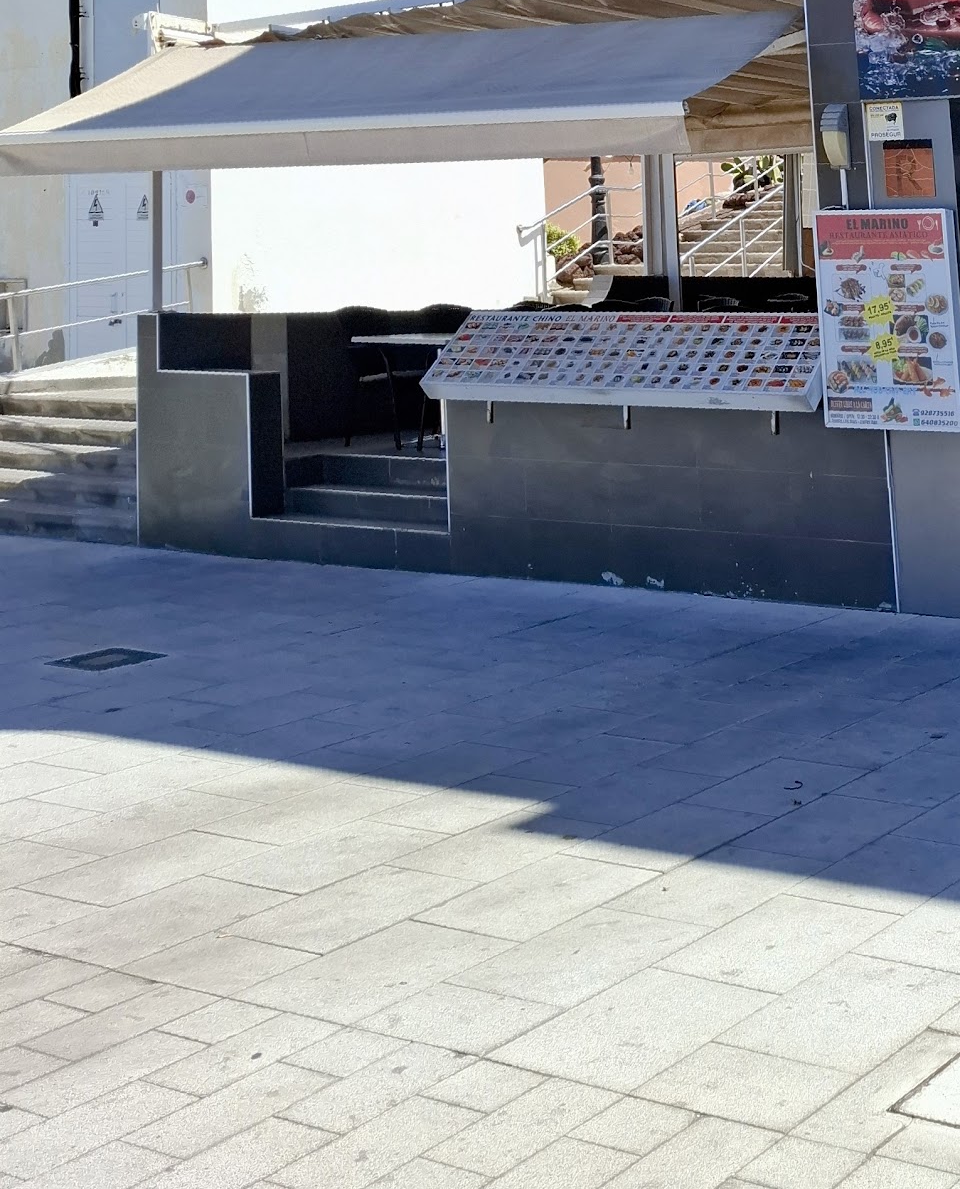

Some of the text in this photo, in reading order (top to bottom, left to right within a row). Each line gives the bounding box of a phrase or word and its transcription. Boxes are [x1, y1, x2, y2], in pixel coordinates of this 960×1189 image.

[846, 217, 909, 230] EL MARINO
[829, 229, 929, 240] RESTAURANTE ASIATICO
[920, 409, 955, 417] 928735516
